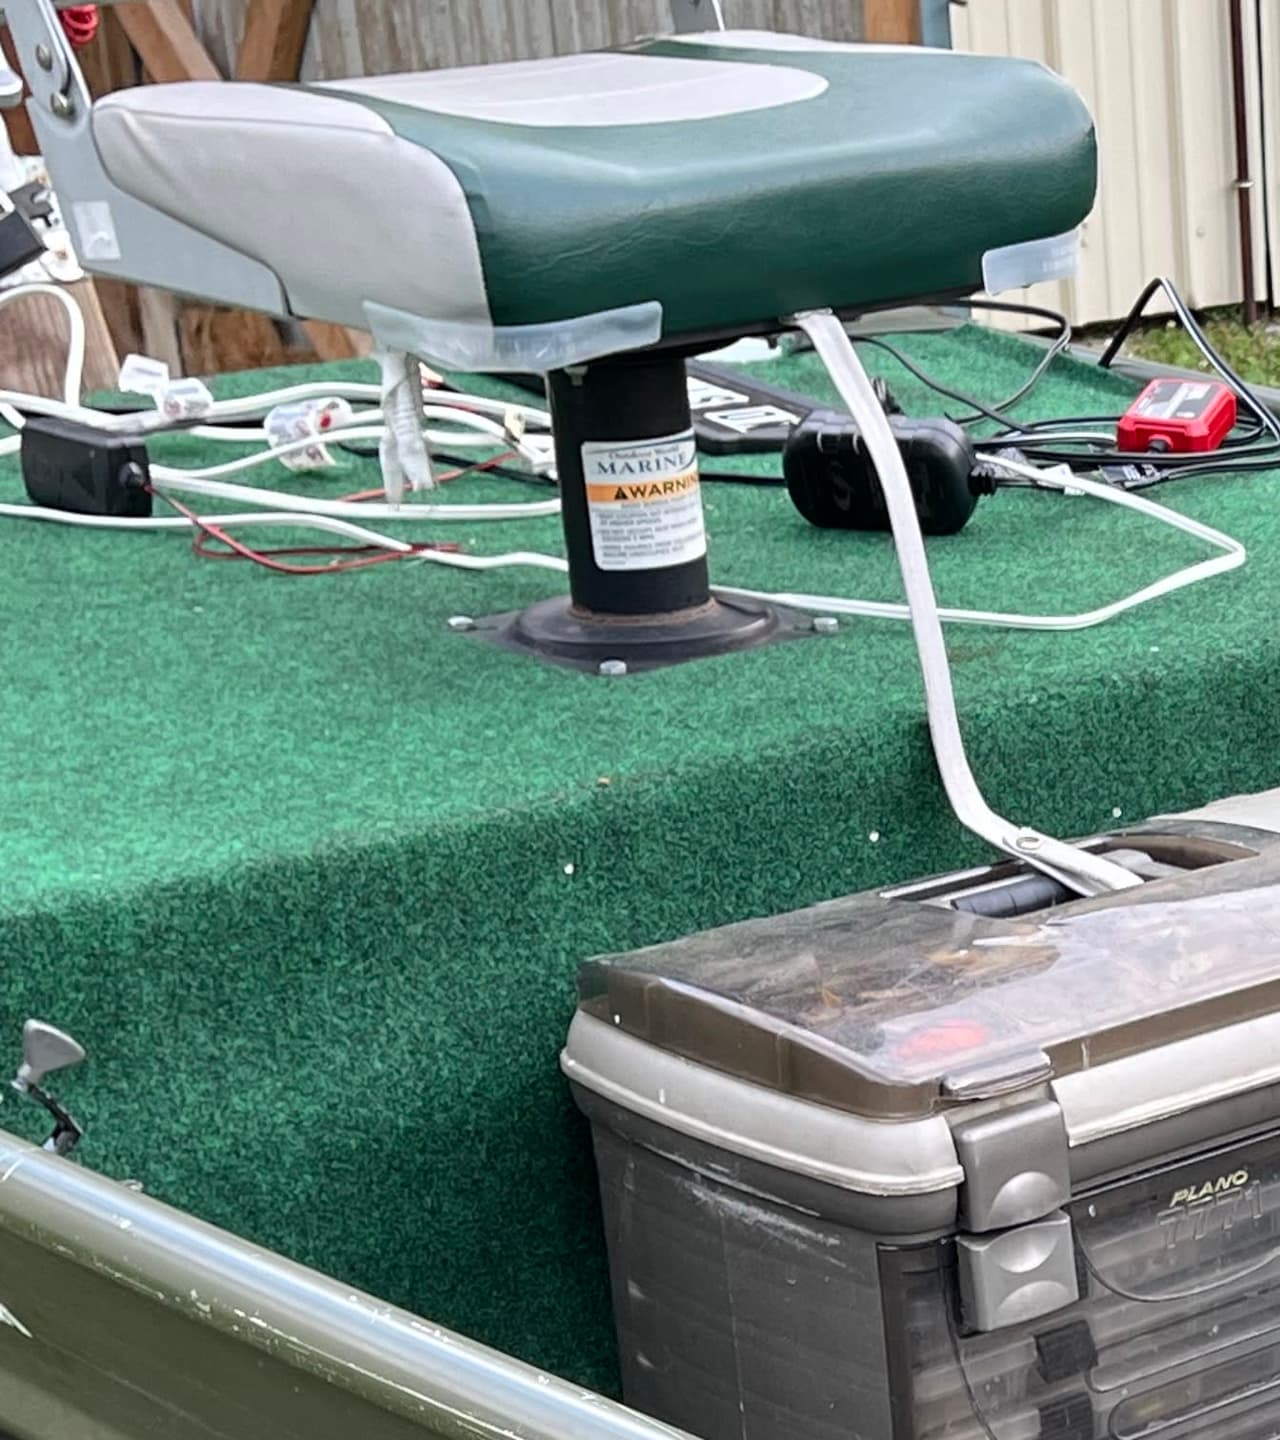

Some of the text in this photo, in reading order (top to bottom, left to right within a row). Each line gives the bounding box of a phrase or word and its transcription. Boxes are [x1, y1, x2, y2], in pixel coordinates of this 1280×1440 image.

[597, 453, 686, 475] MARINE
[628, 473, 698, 498] WARNIN
[1168, 1169, 1249, 1208] PLANO
